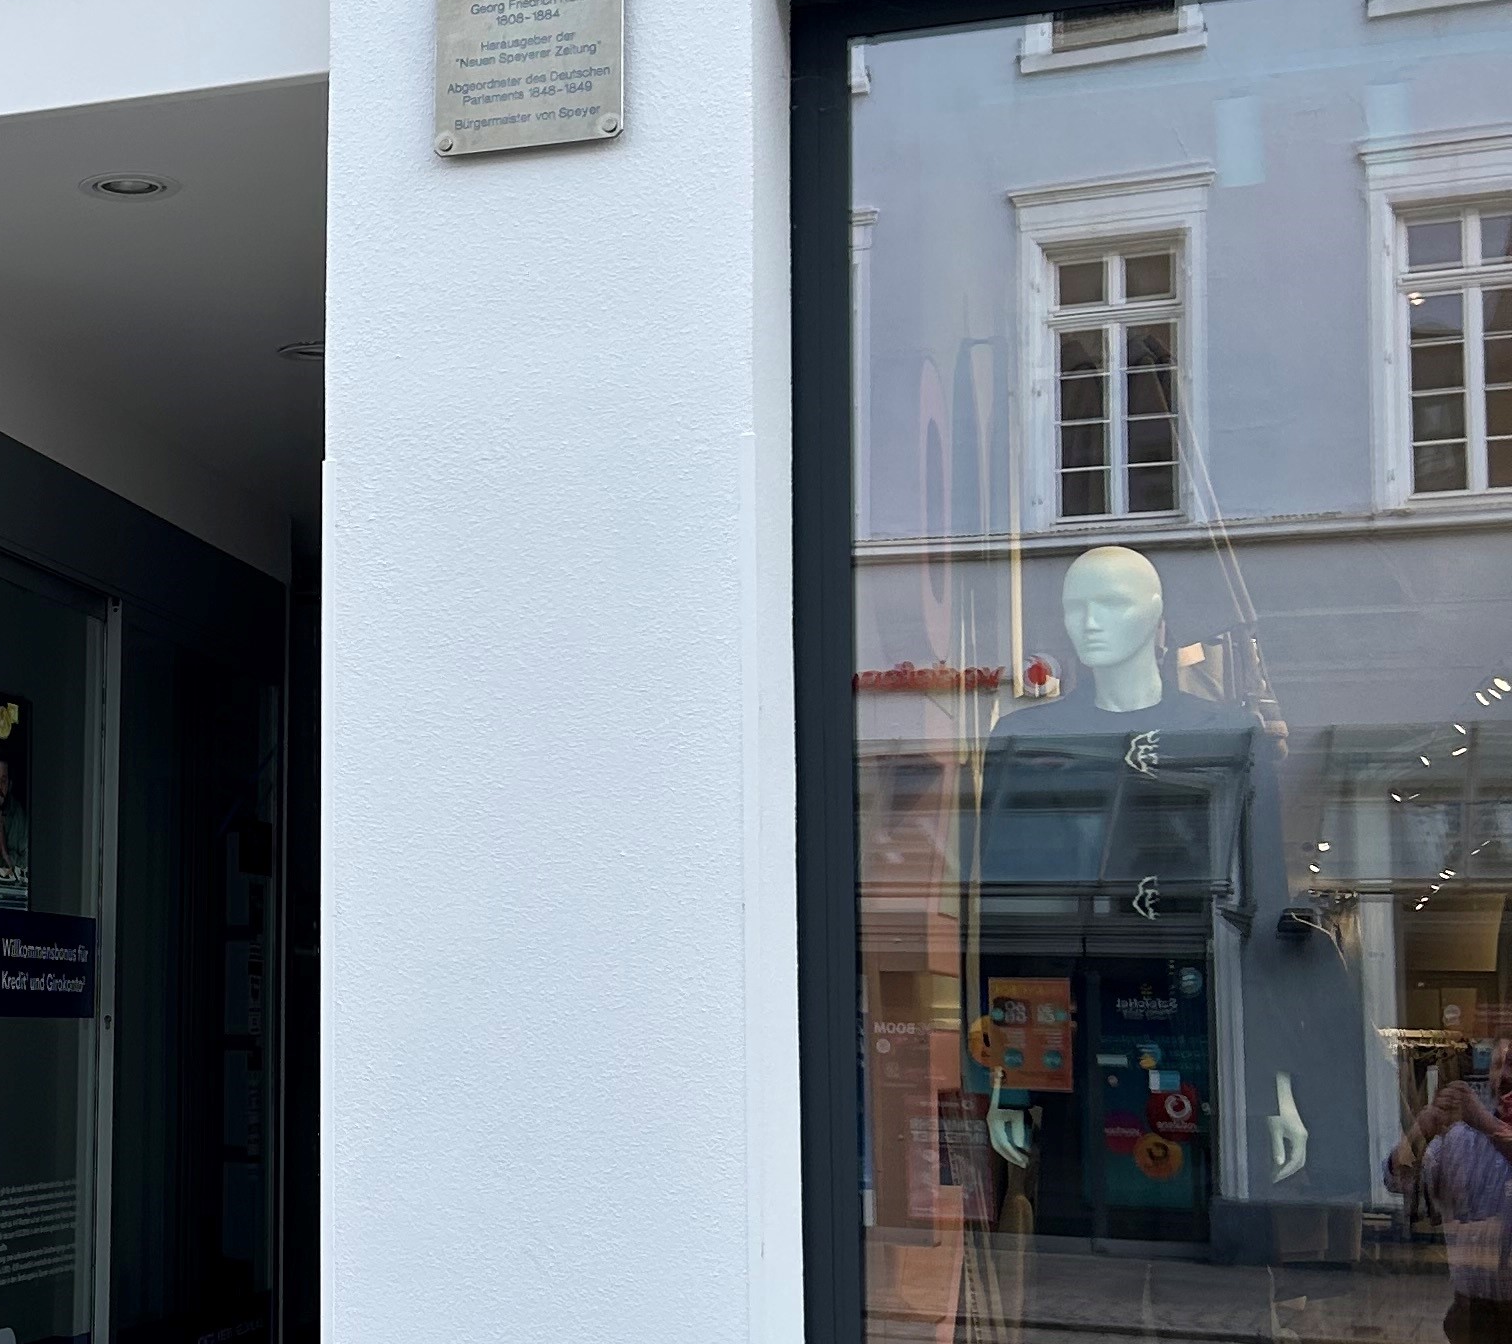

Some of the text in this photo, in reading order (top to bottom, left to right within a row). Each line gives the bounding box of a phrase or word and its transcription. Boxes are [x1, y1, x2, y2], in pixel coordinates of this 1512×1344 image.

[470, 1, 505, 15] Georg
[480, 30, 576, 53] Herausgeber der
[498, 48, 552, 65] Speyerer
[447, 66, 611, 95] Abgeordneter des Deutschen
[462, 89, 525, 106] Parlaments
[454, 105, 601, 131] Bürgermeister von Speyer
[1, 938, 89, 963] Willkommensbonus für
[30, 973, 45, 991] und
